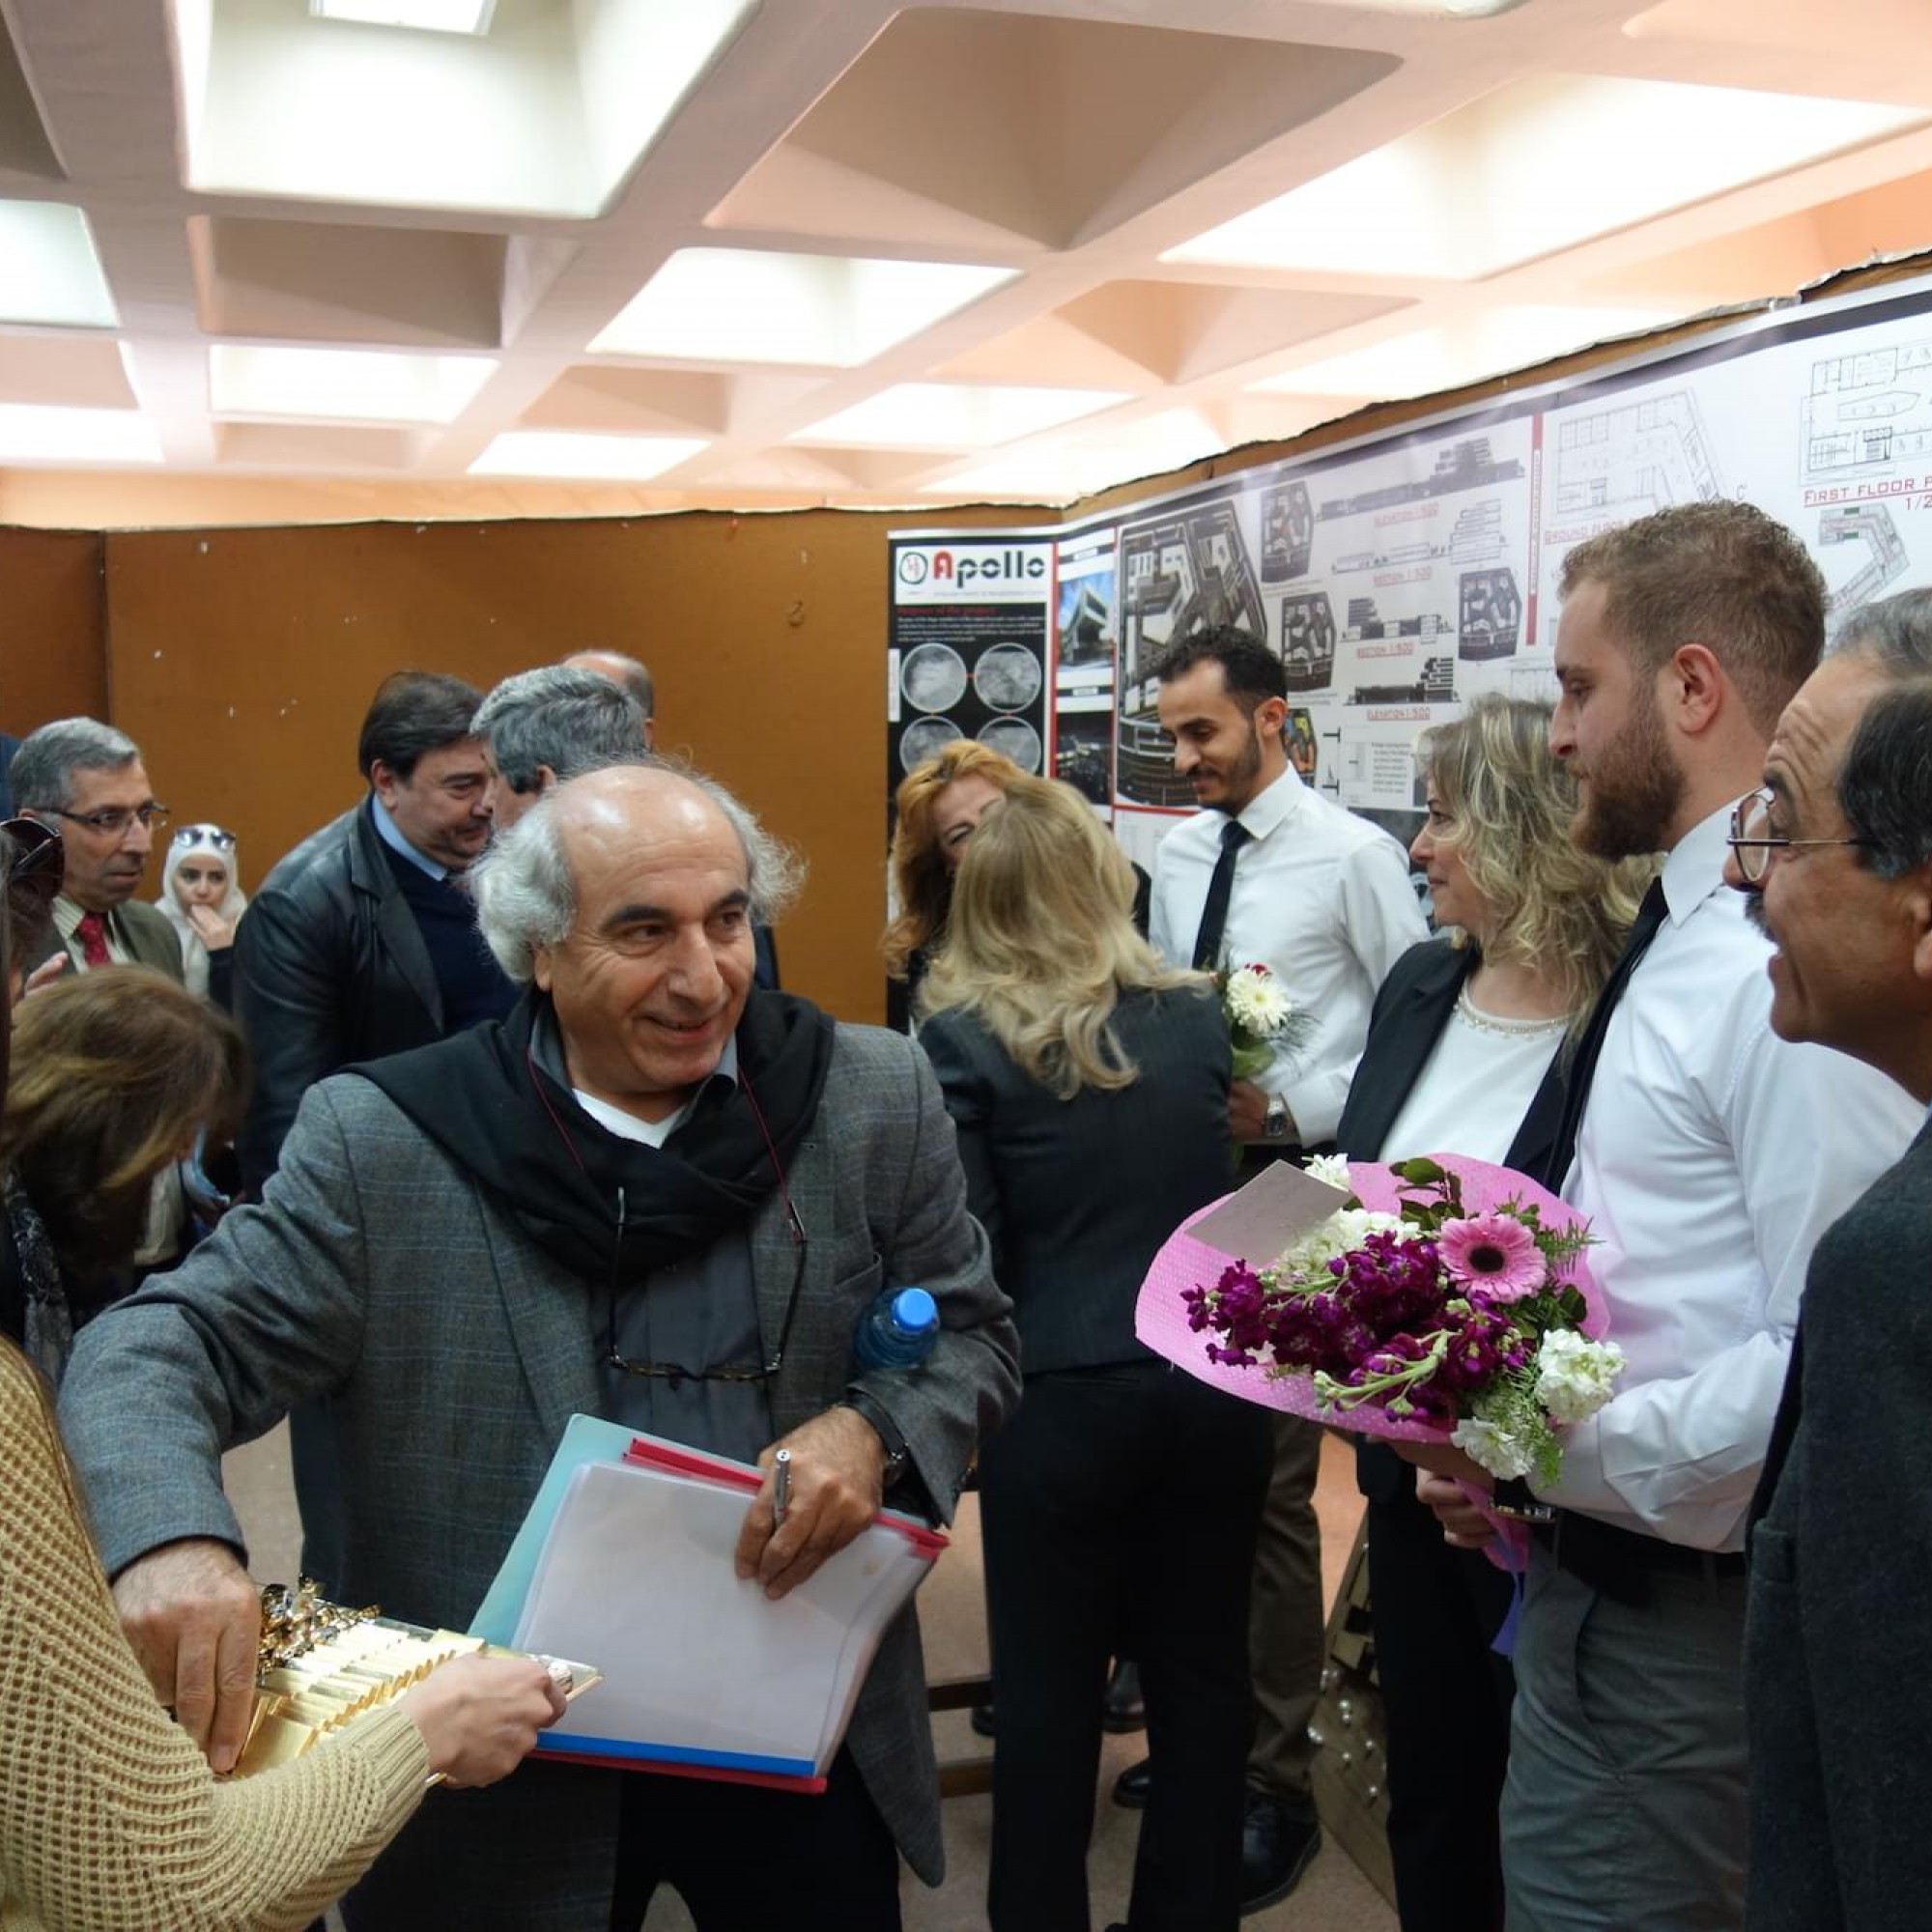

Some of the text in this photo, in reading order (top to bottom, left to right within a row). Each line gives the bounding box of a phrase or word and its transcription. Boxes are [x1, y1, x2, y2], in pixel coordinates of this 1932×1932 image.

[1804, 487, 1850, 505] FIRST
[1858, 477, 1915, 497] FLOOR
[933, 550, 1045, 588] Apollo
